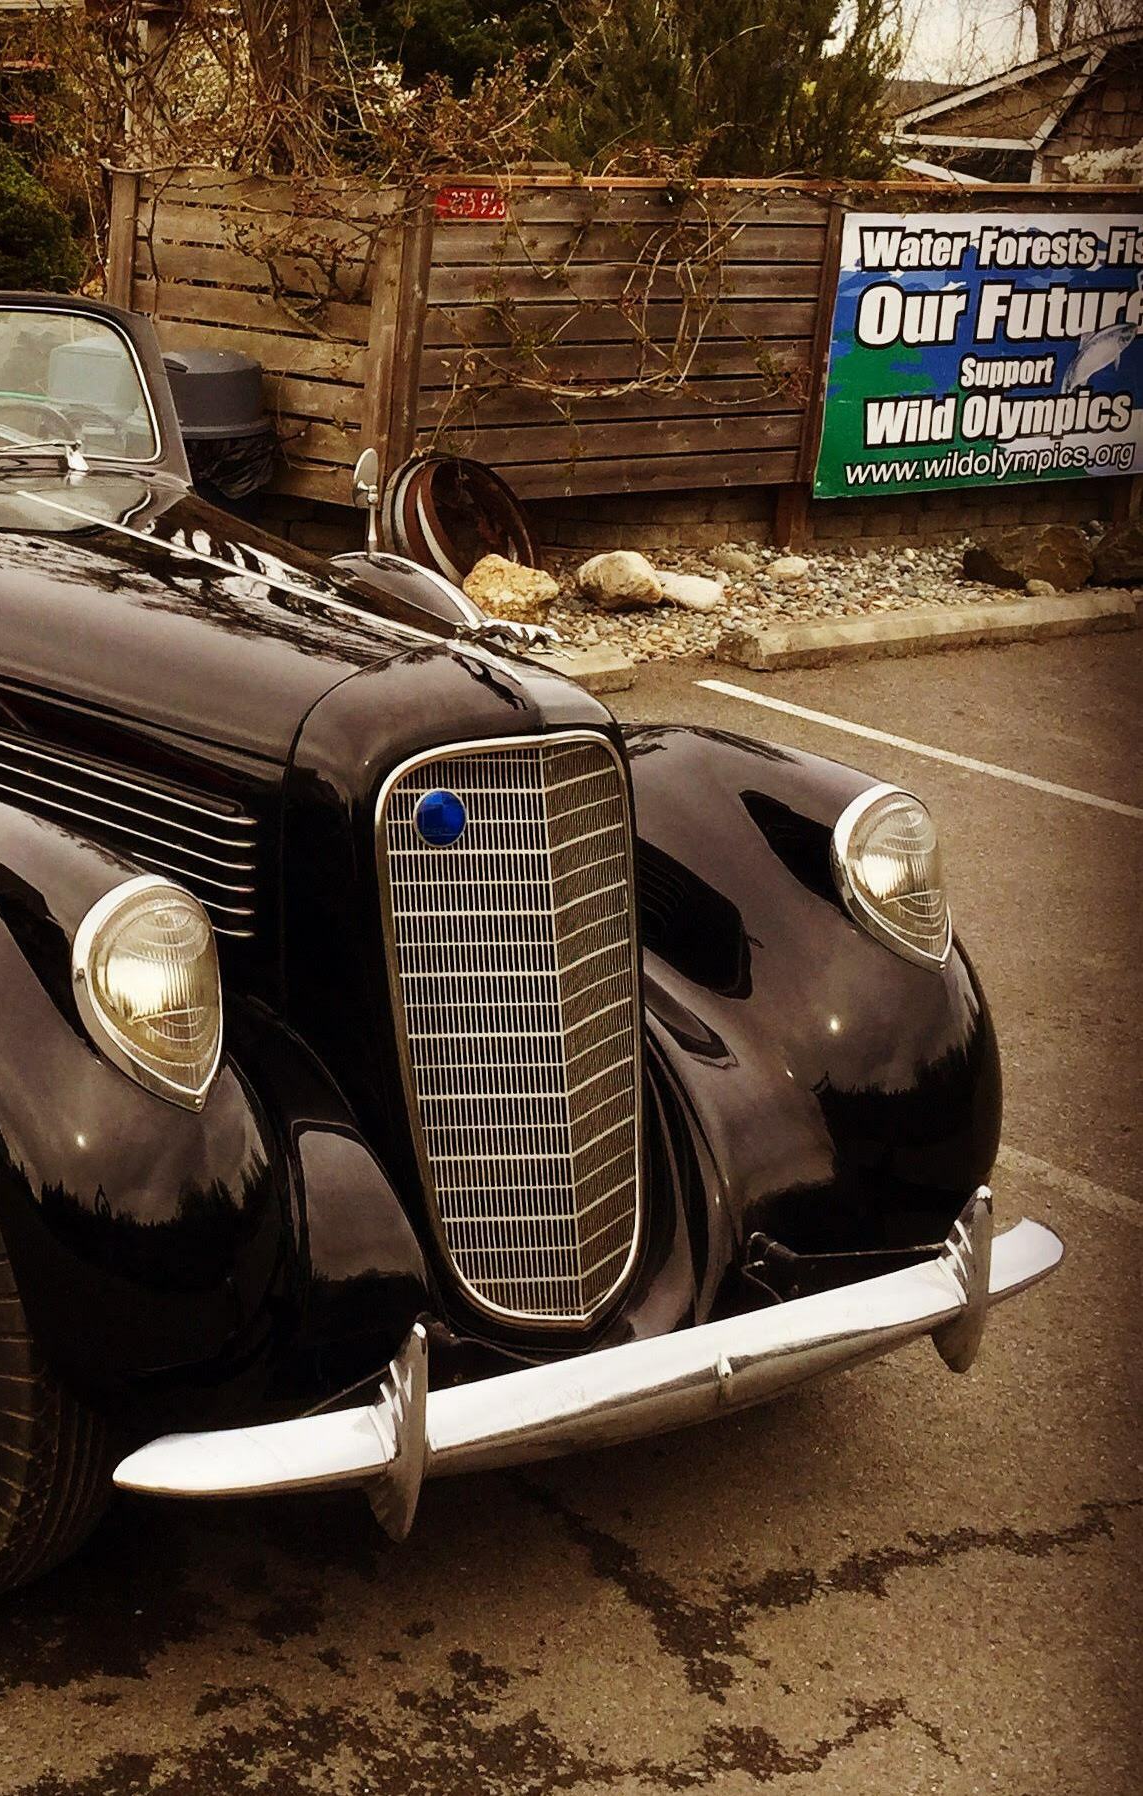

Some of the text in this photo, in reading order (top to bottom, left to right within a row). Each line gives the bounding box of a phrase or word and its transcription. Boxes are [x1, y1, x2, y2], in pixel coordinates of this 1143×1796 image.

[862, 230, 969, 267] Water
[977, 229, 1097, 266] Forests
[857, 284, 967, 346] Our
[960, 355, 1055, 389] Support
[865, 390, 1132, 446] Wild Olympics
[845, 443, 1136, 485] www.wildolympics.org
